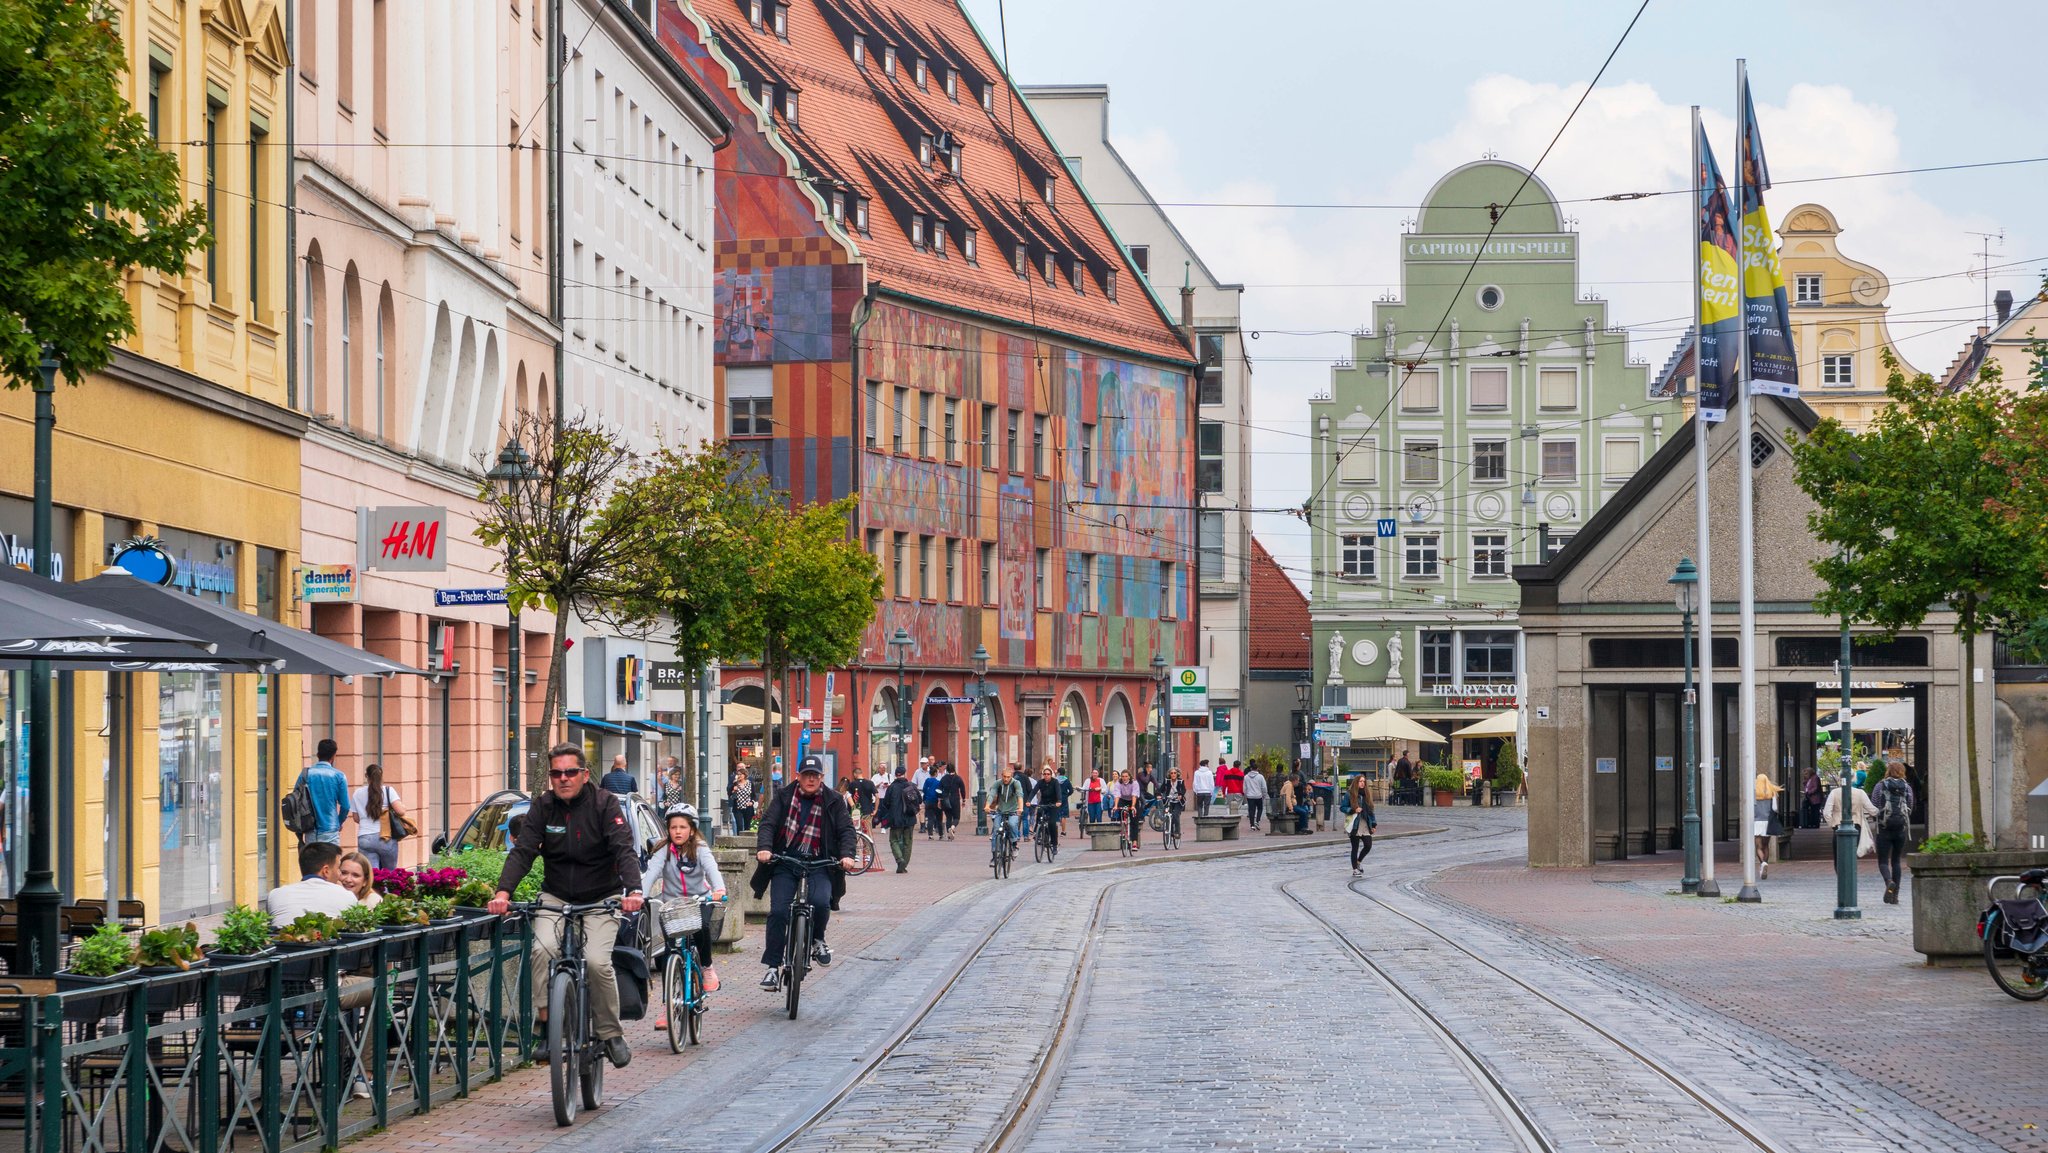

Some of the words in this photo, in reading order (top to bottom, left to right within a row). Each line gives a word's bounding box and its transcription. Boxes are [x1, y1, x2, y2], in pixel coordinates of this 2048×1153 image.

[1750, 304, 1773, 313] man
[1701, 357, 1719, 367] acht
[1379, 521, 1394, 535] W
[382, 520, 439, 560] H&M
[305, 568, 351, 585] dampf
[1432, 684, 1494, 697] HENRY'S
[1497, 684, 1518, 697] CO
[1463, 697, 1520, 709] CAPITO
